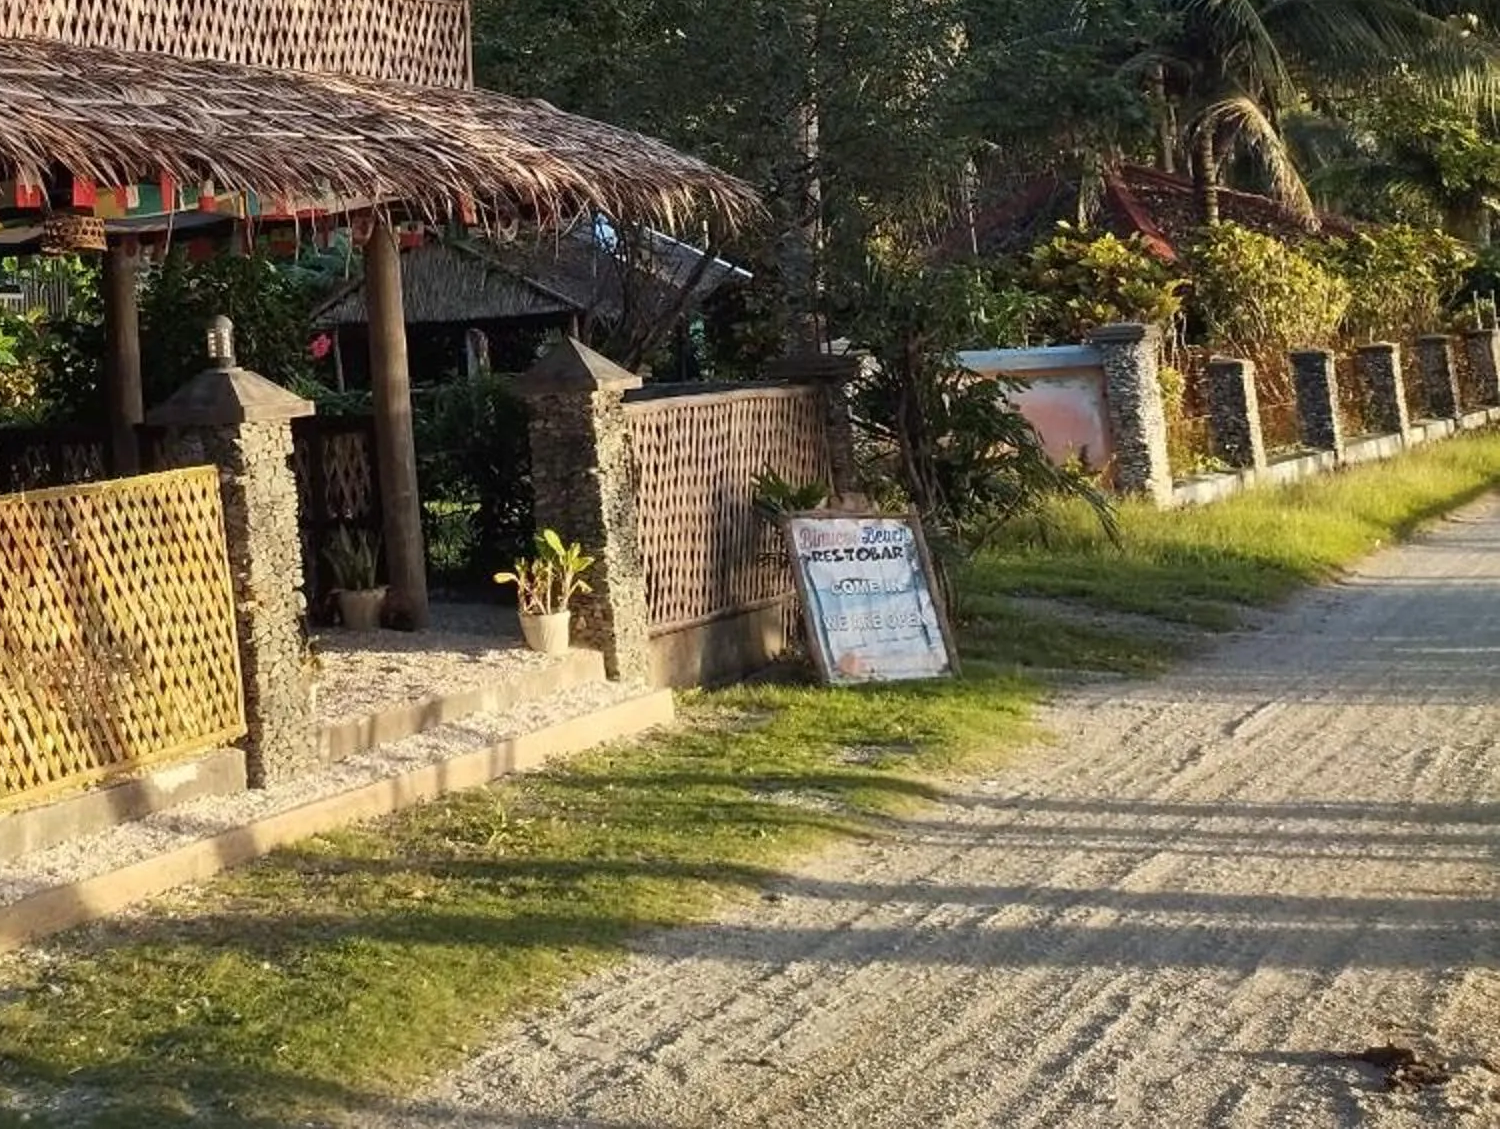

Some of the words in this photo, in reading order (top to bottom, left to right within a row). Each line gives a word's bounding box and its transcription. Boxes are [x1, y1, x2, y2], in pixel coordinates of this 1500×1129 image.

[800, 528, 858, 548] Binuc
[831, 578, 879, 596] COME
[822, 615, 848, 631] WE
